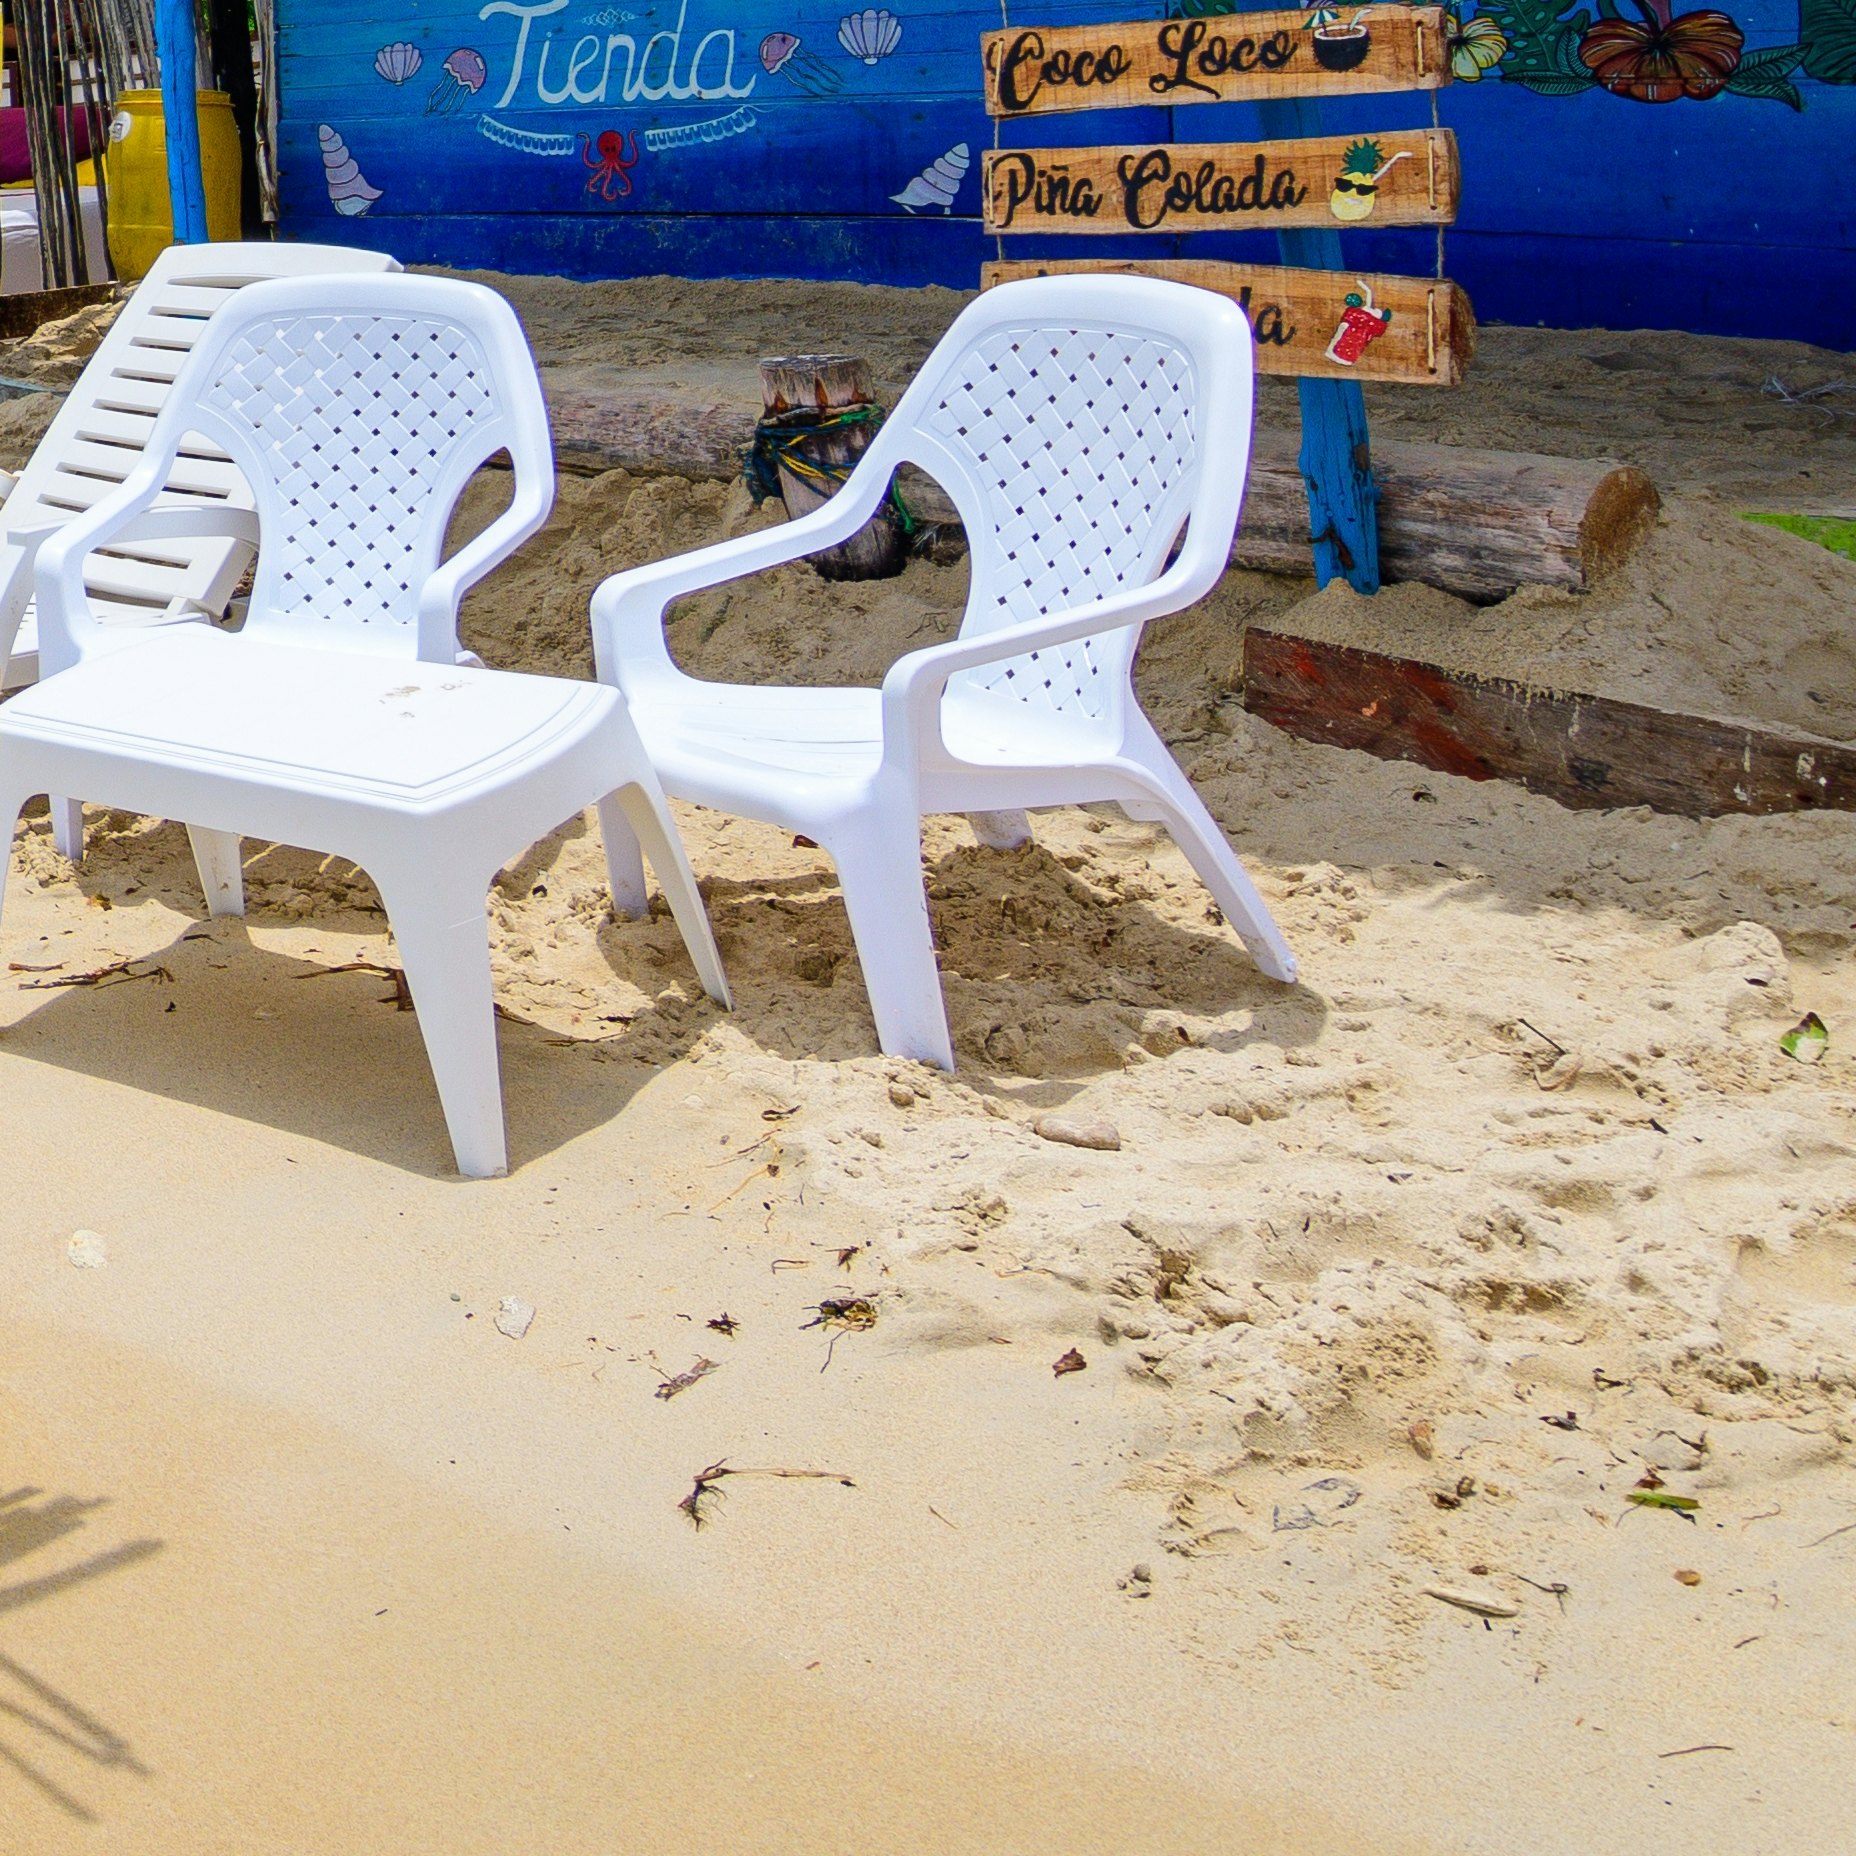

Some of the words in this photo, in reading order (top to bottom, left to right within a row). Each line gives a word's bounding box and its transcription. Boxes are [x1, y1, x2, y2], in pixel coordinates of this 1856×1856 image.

[988, 30, 1132, 112] Coco
[1148, 20, 1300, 101] Loco
[984, 151, 1104, 230] Piña
[1118, 147, 1308, 230] Colada
